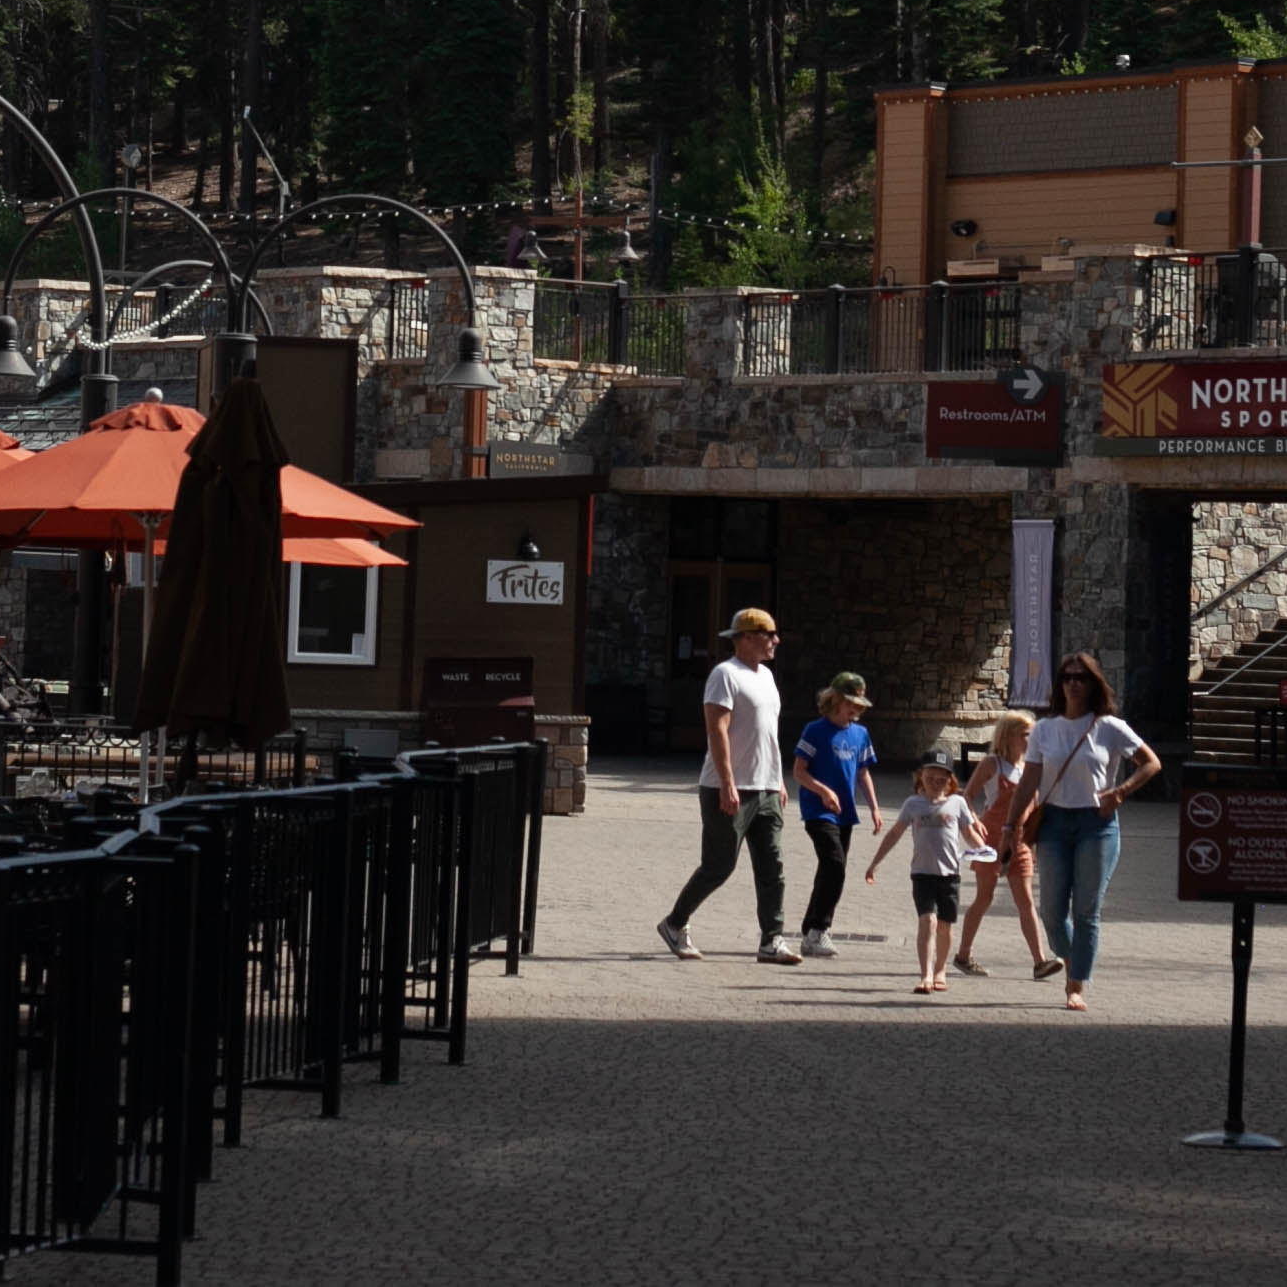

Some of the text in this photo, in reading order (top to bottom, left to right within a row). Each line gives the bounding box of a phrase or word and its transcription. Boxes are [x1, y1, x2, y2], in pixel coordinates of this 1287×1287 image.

[938, 406, 1047, 424] Restrooms/ATM
[1158, 439, 1266, 454] PERFORMANCE
[496, 453, 555, 466] NORTHSTAR
[490, 565, 561, 601] Frites
[441, 672, 521, 682] WASTE RECYCLE
[1227, 795, 1246, 805] NO
[1227, 837, 1246, 847] NO
[1234, 850, 1287, 861] ALCOHOL
